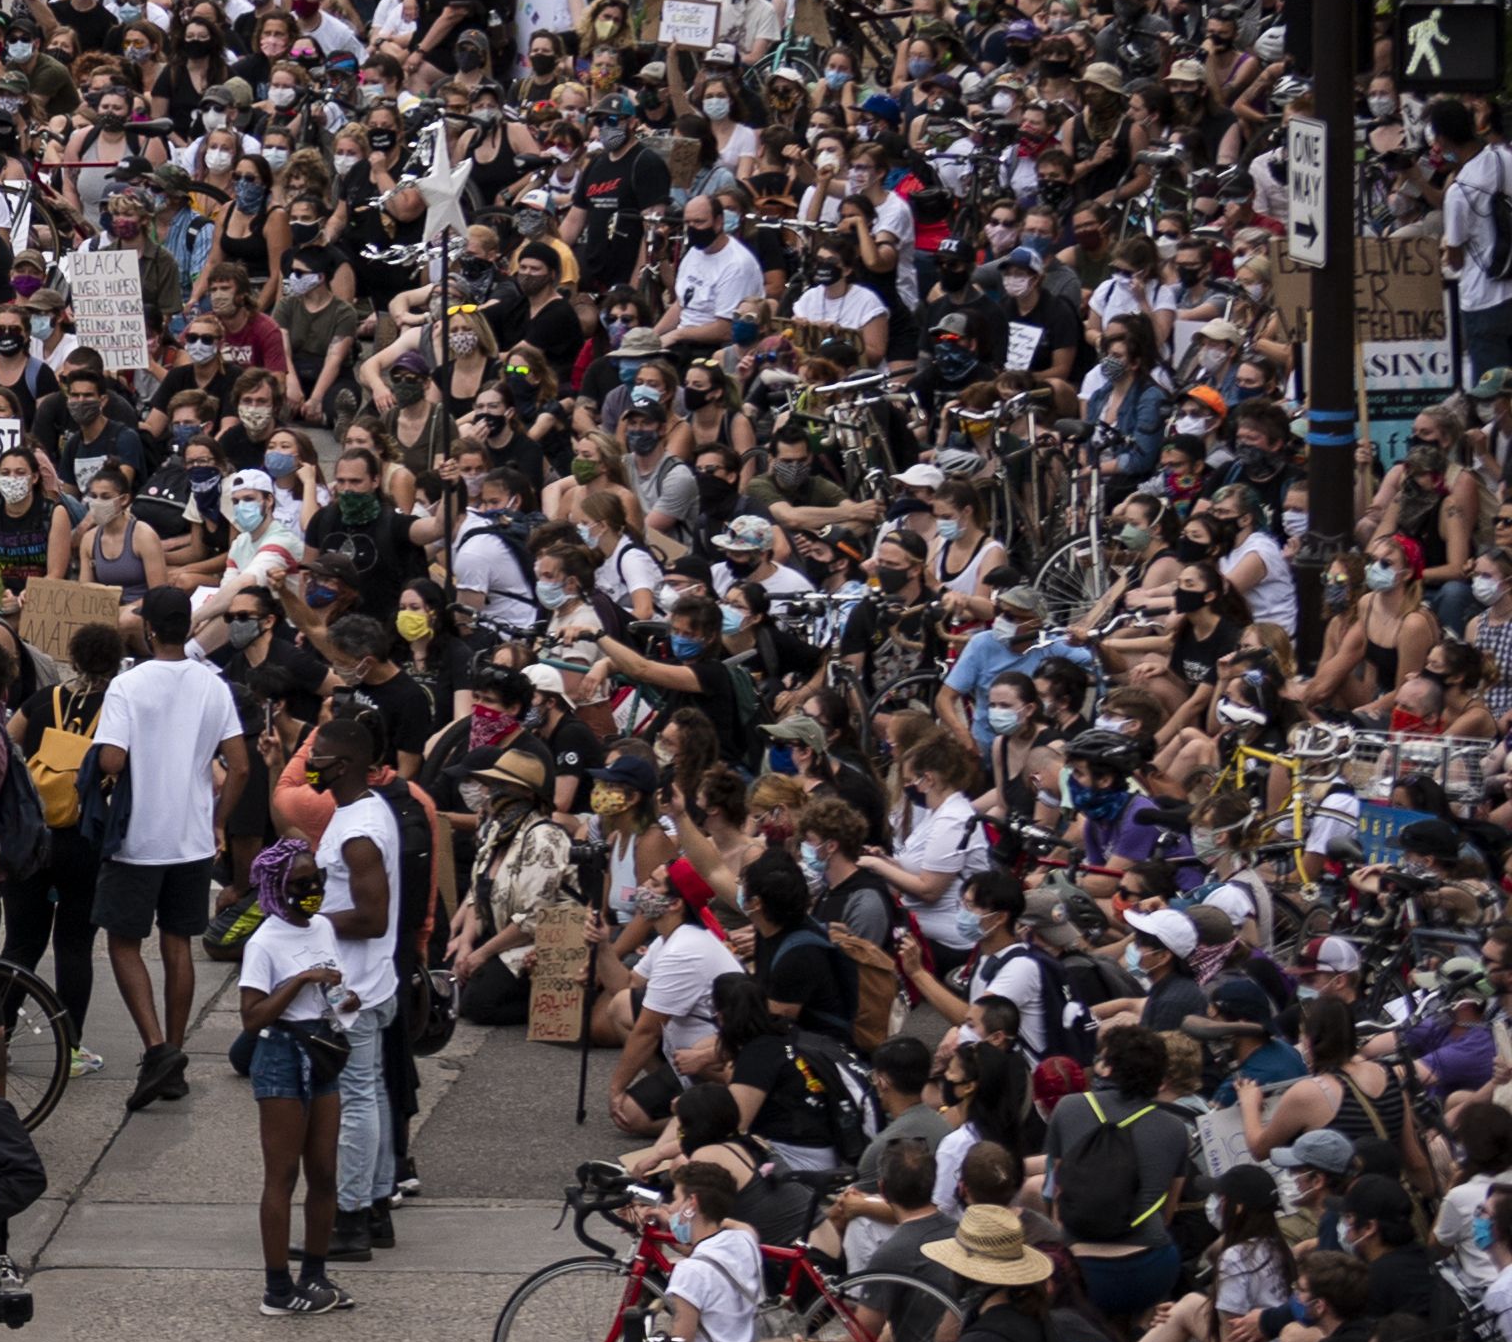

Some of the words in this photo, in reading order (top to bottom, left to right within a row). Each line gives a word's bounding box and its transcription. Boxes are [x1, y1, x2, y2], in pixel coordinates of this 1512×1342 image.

[1291, 131, 1320, 163] ONE
[1291, 173, 1321, 206] WAY
[72, 254, 127, 277] BLACK
[1364, 235, 1435, 277] LIVES
[71, 279, 101, 296] LIVES
[104, 278, 139, 295] HOPES
[71, 299, 114, 316] FUTURES
[114, 297, 144, 315] VIEWS
[74, 317, 118, 334] FEELINGS
[121, 318, 144, 334] AND
[98, 349, 146, 368] TTER!
[1364, 349, 1449, 379] SING
[26, 587, 75, 615] BLACK
[81, 594, 119, 617] LIVES
